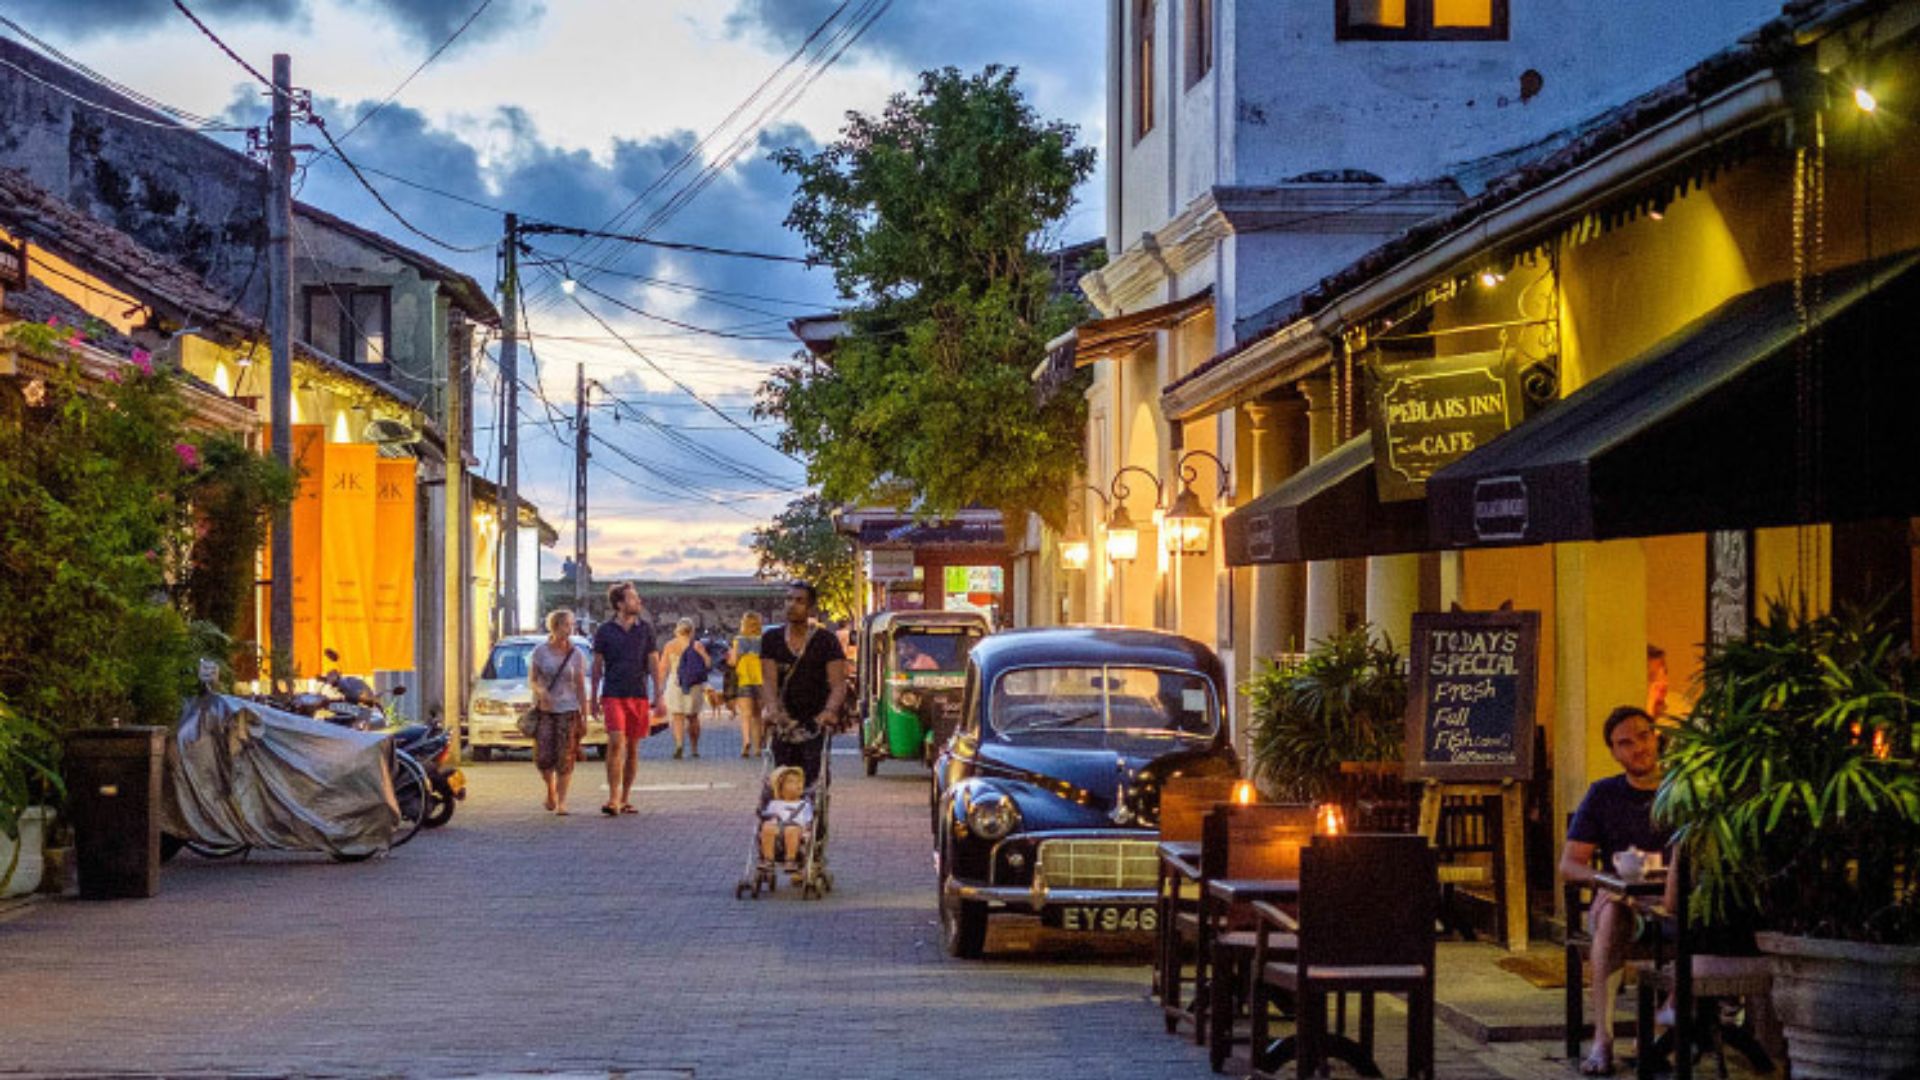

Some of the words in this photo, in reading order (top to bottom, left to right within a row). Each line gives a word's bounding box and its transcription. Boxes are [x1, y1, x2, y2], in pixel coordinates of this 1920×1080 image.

[1468, 393, 1504, 416] INN
[1421, 432, 1475, 455] CAFE
[1429, 653, 1519, 675] SPECIAL
[1434, 678, 1496, 702] Fresh
